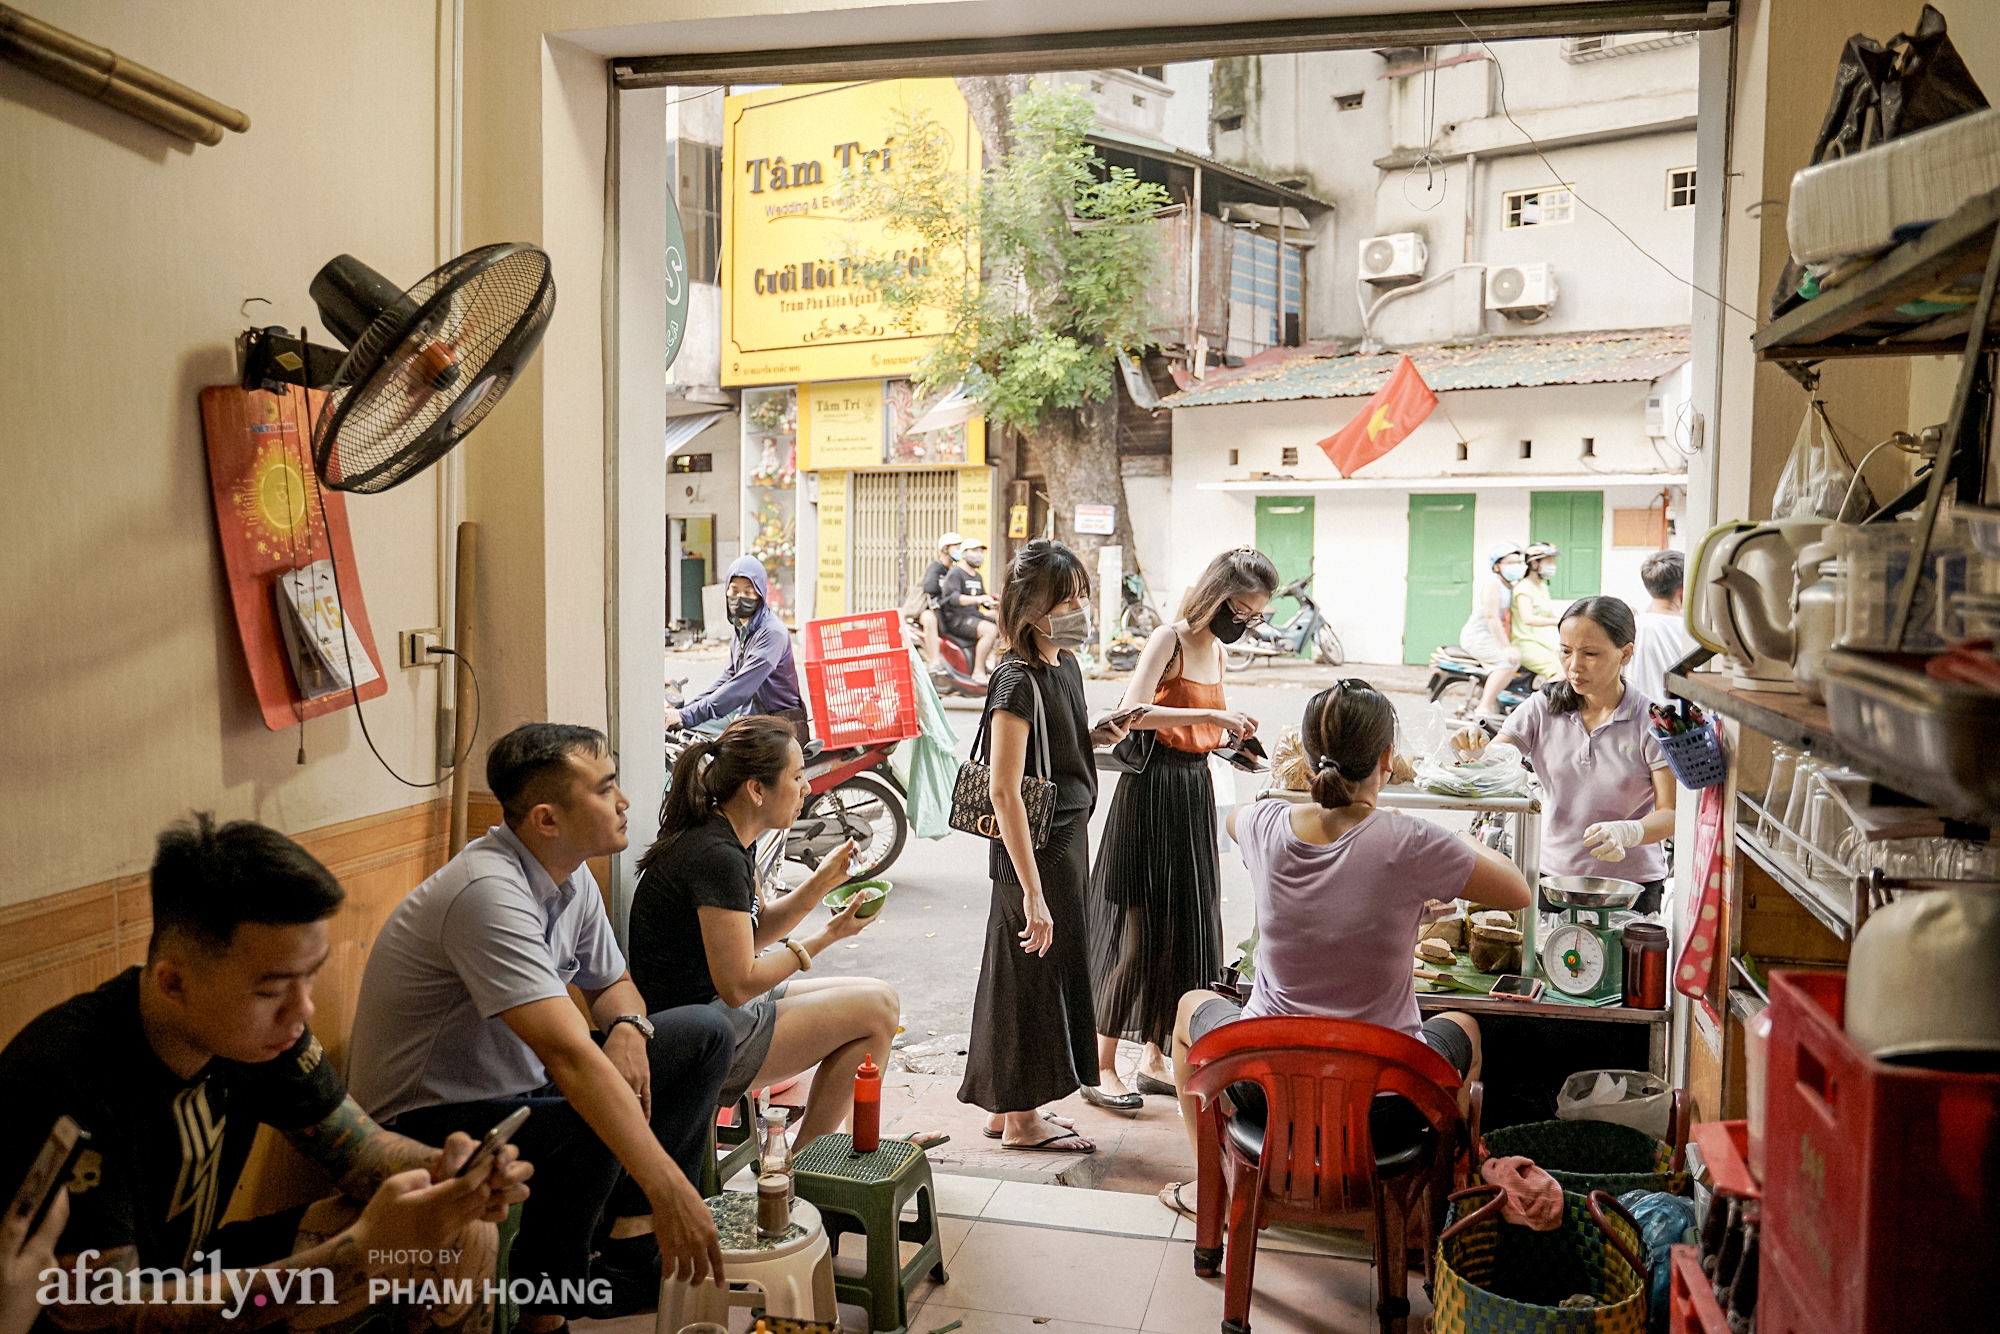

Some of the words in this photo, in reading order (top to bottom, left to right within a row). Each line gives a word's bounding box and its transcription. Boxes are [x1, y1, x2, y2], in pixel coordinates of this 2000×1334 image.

[746, 156, 823, 194] Tâm
[833, 136, 895, 175] Trí
[766, 201, 809, 217] Wedding
[754, 263, 798, 295] Cưới
